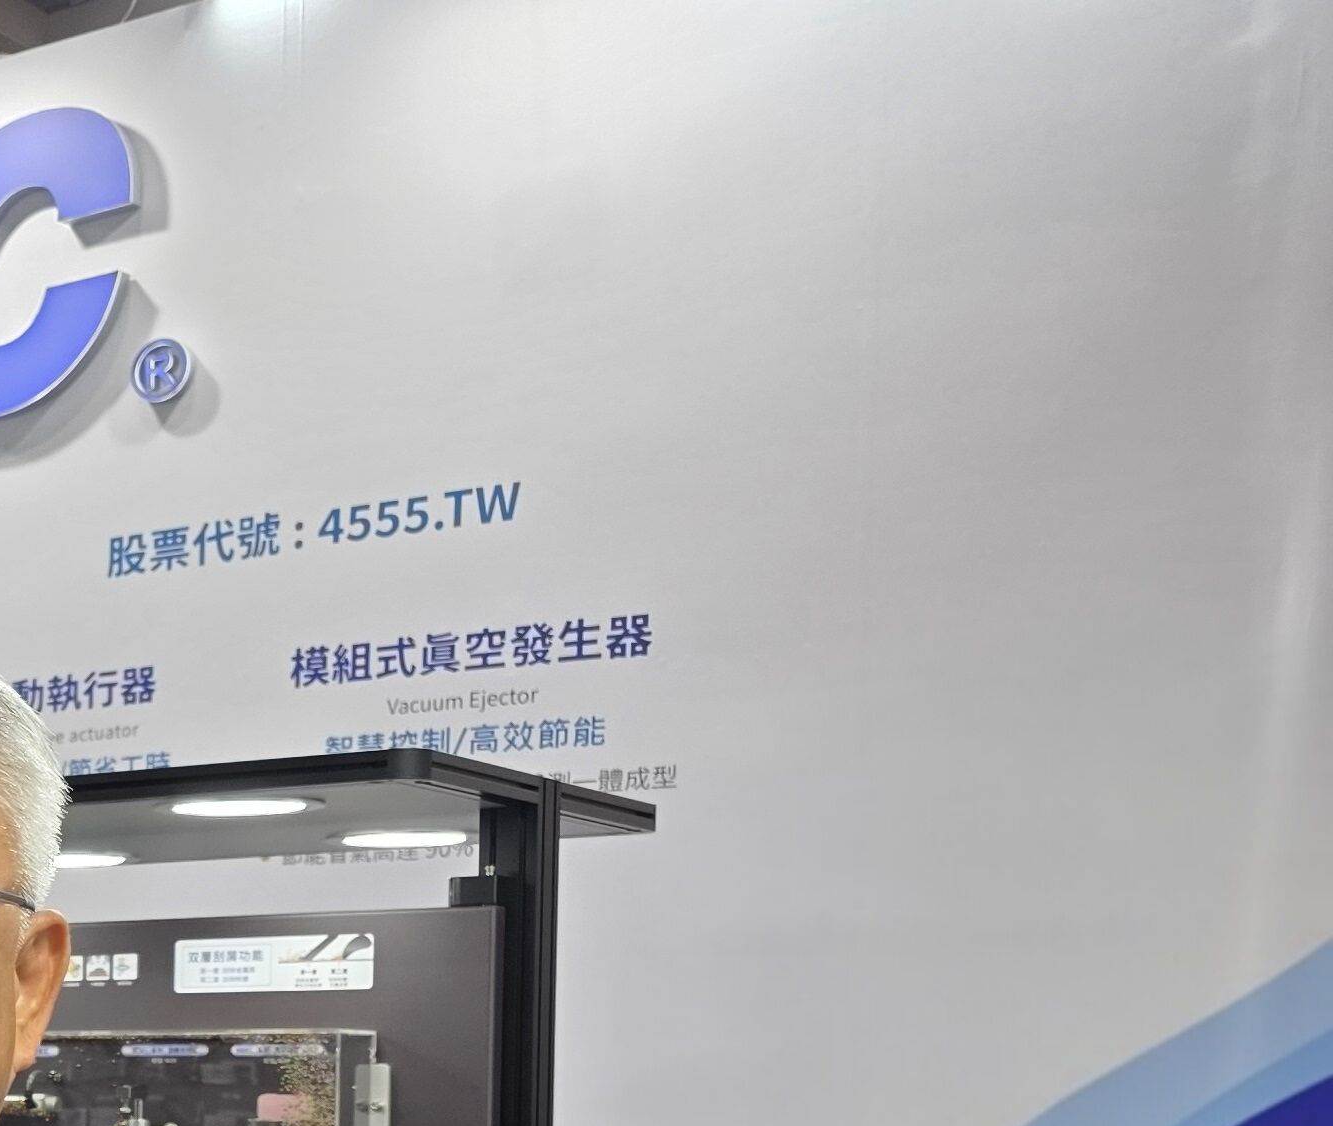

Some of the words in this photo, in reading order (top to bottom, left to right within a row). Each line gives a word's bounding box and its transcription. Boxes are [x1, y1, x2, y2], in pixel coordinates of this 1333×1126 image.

[317, 480, 522, 545] 4555.TW
[386, 691, 464, 717] Vacuum
[469, 684, 539, 714] Ejector
[69, 724, 140, 743] actuator
